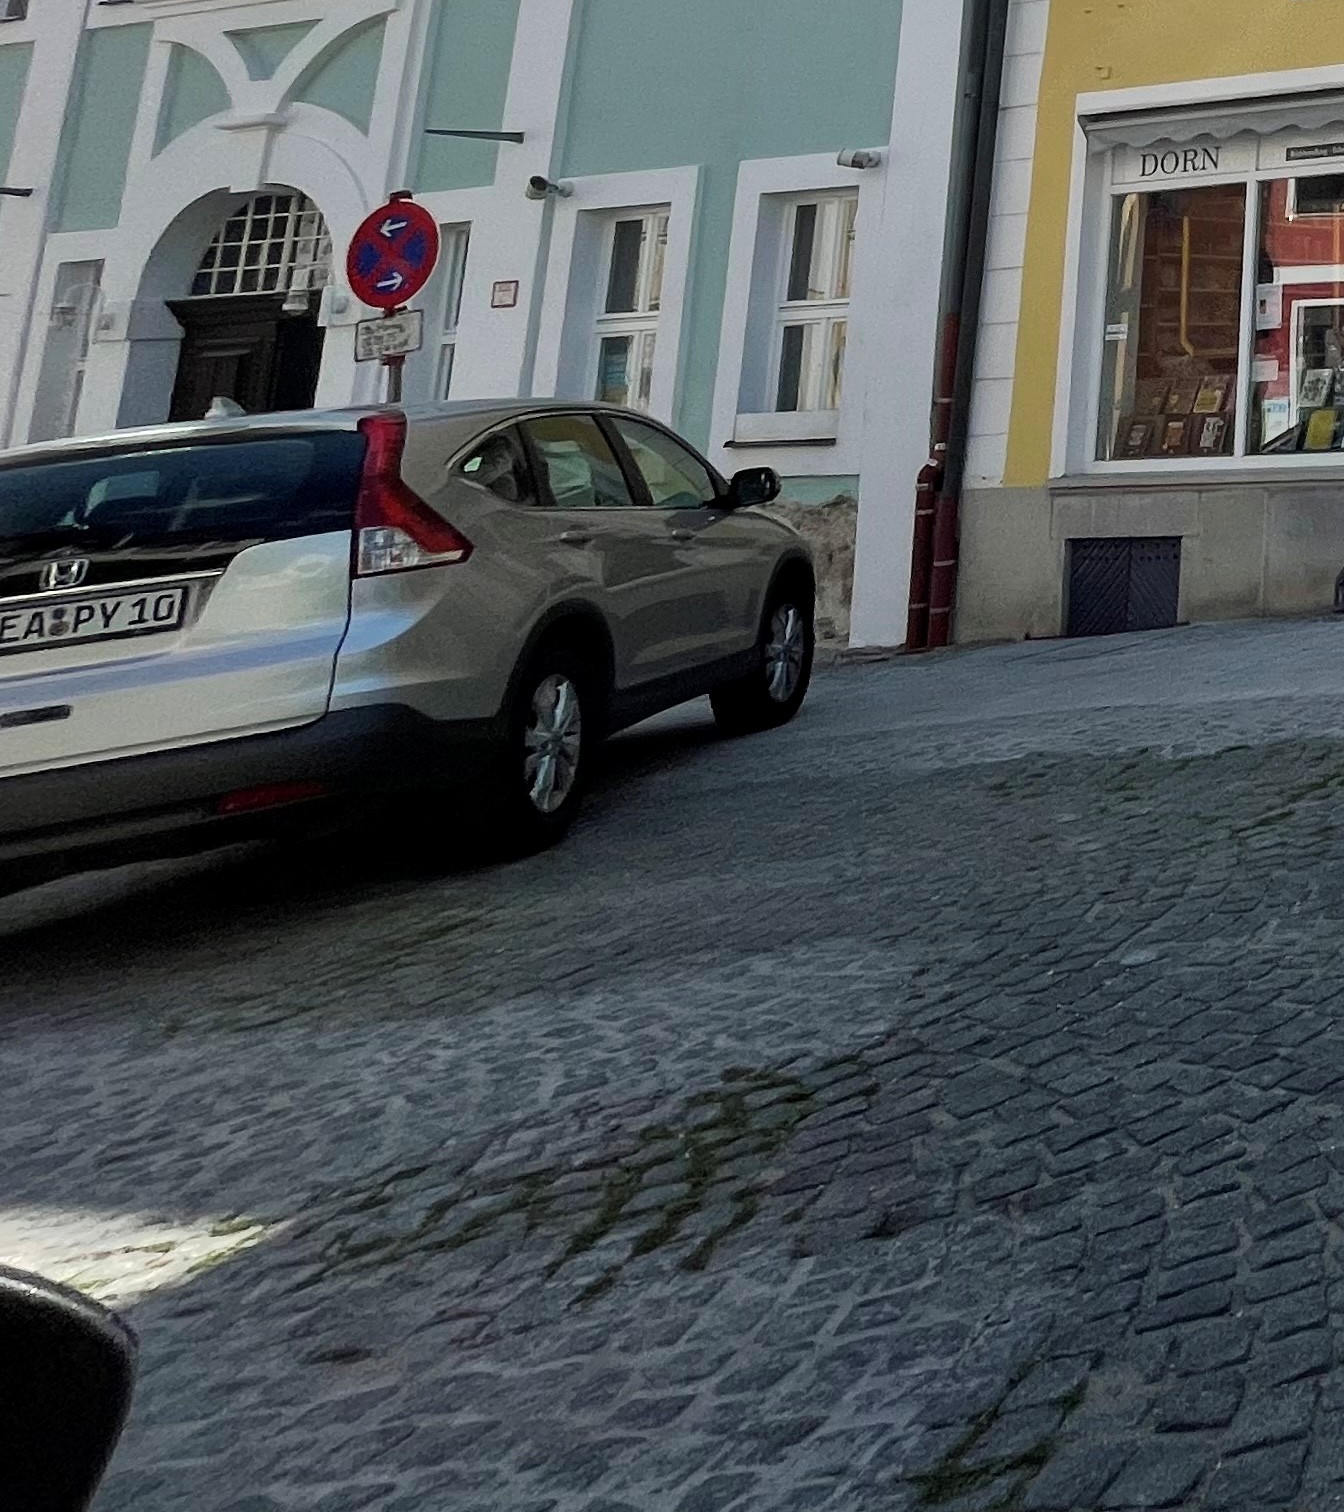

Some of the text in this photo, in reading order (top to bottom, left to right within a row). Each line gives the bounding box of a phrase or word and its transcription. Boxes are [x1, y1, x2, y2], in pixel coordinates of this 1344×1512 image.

[1139, 146, 1222, 177] DORN
[72, 600, 123, 634] PY
[127, 594, 176, 626] 10
